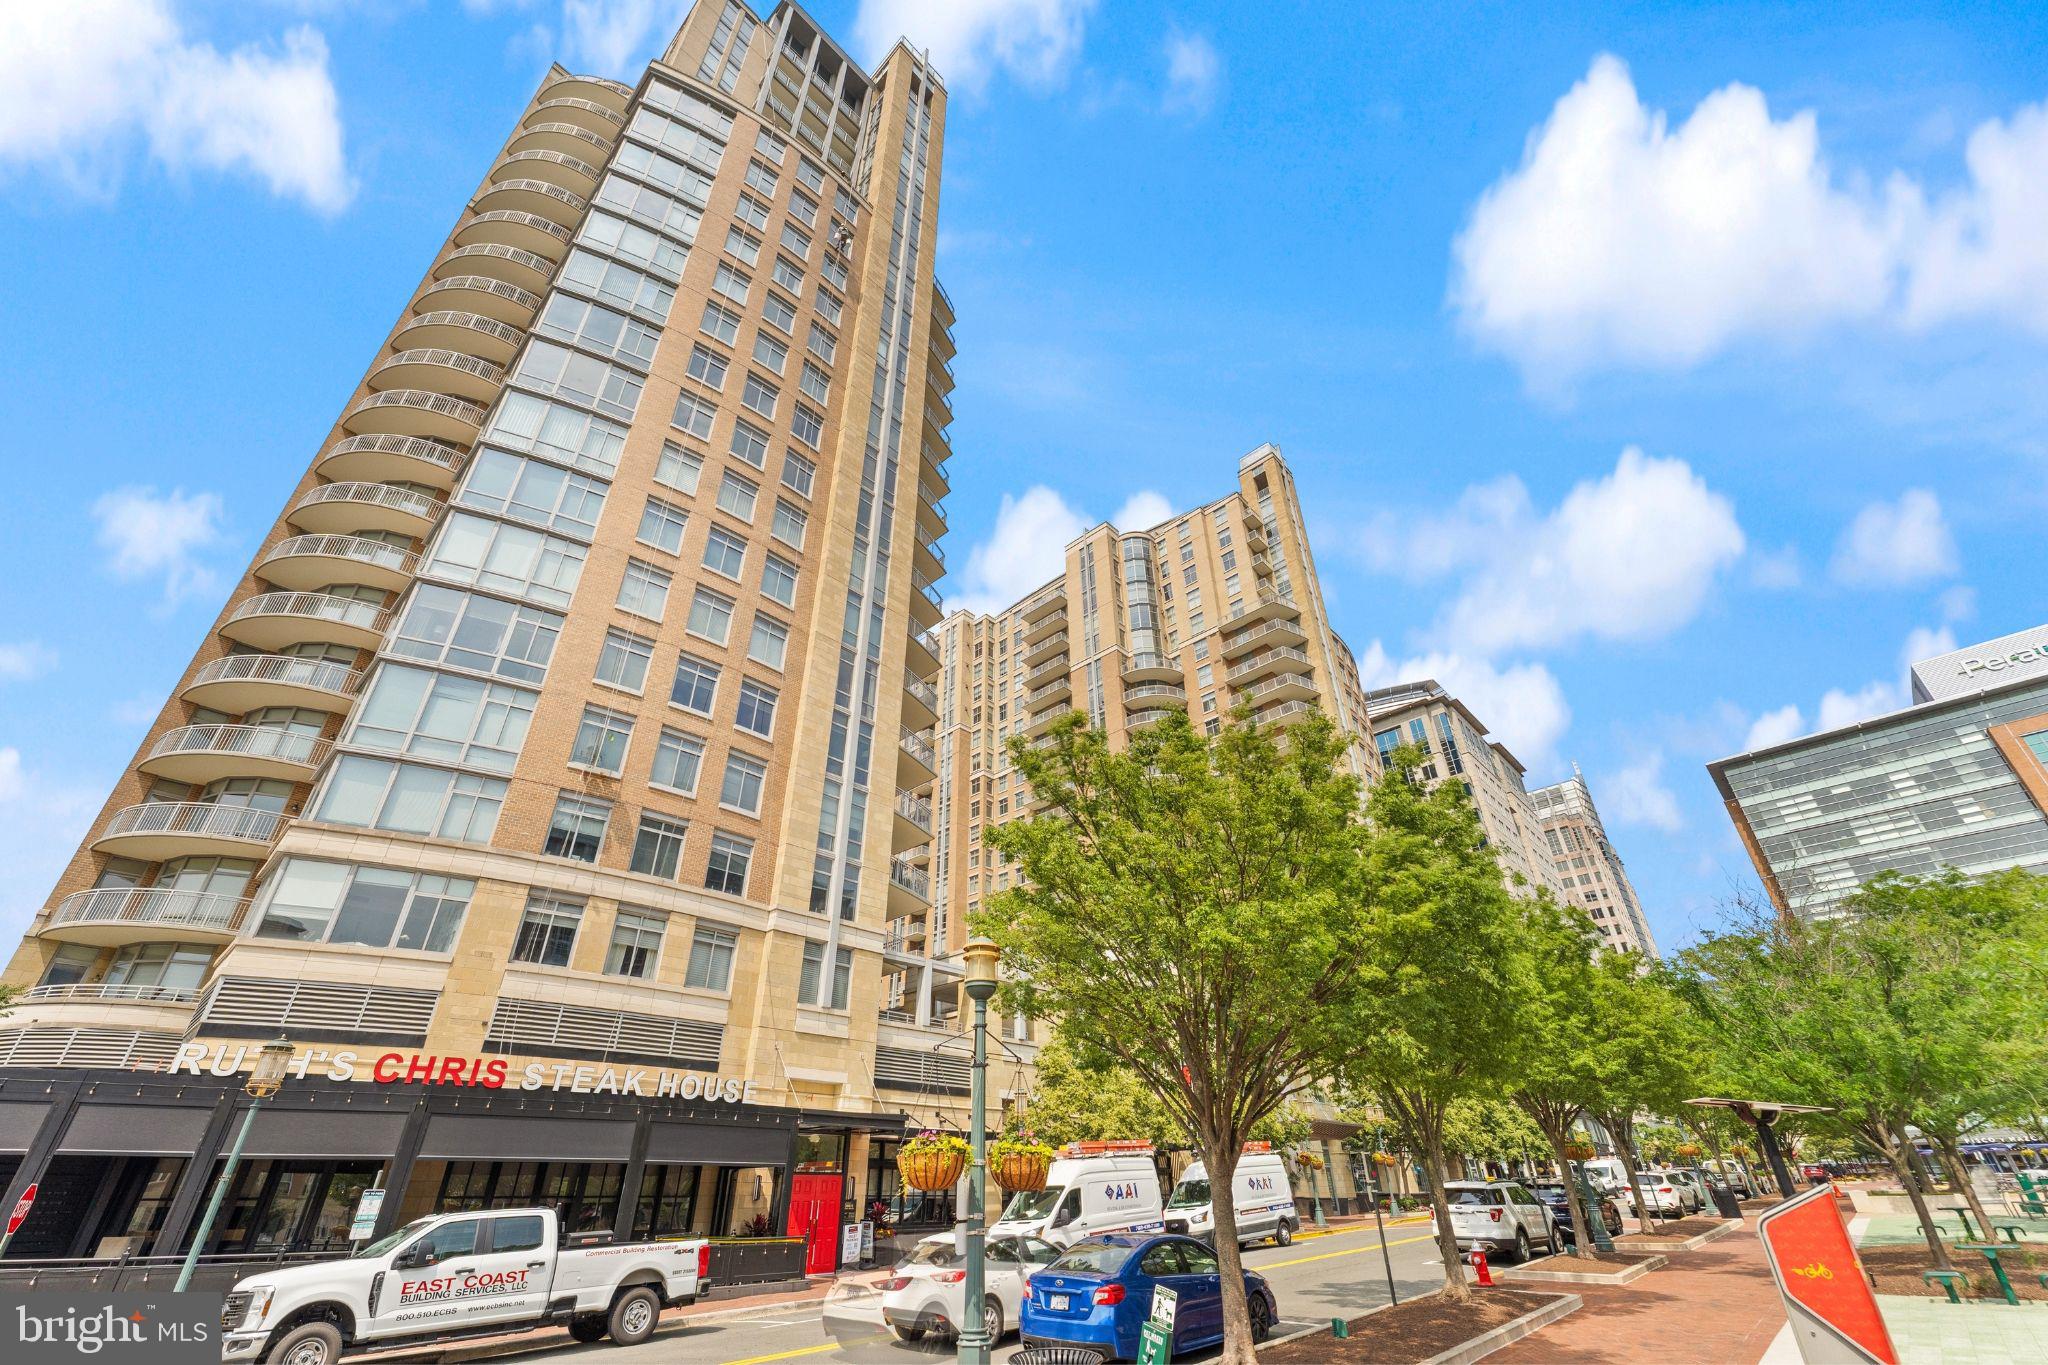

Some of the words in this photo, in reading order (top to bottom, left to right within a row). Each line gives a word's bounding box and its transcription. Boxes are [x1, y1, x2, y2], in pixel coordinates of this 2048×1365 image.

[167, 1042, 358, 1082] RUH'S
[373, 1052, 509, 1090] CHRIS
[521, 1063, 645, 1095] STEAK
[657, 1072, 761, 1105] HOUSE
[12, 1200, 33, 1218] STOP
[585, 1248, 621, 1257] Commercial
[623, 1246, 645, 1254] Building
[647, 1244, 678, 1252] Restoration
[401, 1277, 456, 1295] EAST
[464, 1269, 529, 1288] COAST
[400, 1290, 450, 1304] BUILDING
[455, 1284, 508, 1297] SERVICES,
[511, 1281, 528, 1290] LLC
[467, 1300, 525, 1313] www.ecbsinc.net
